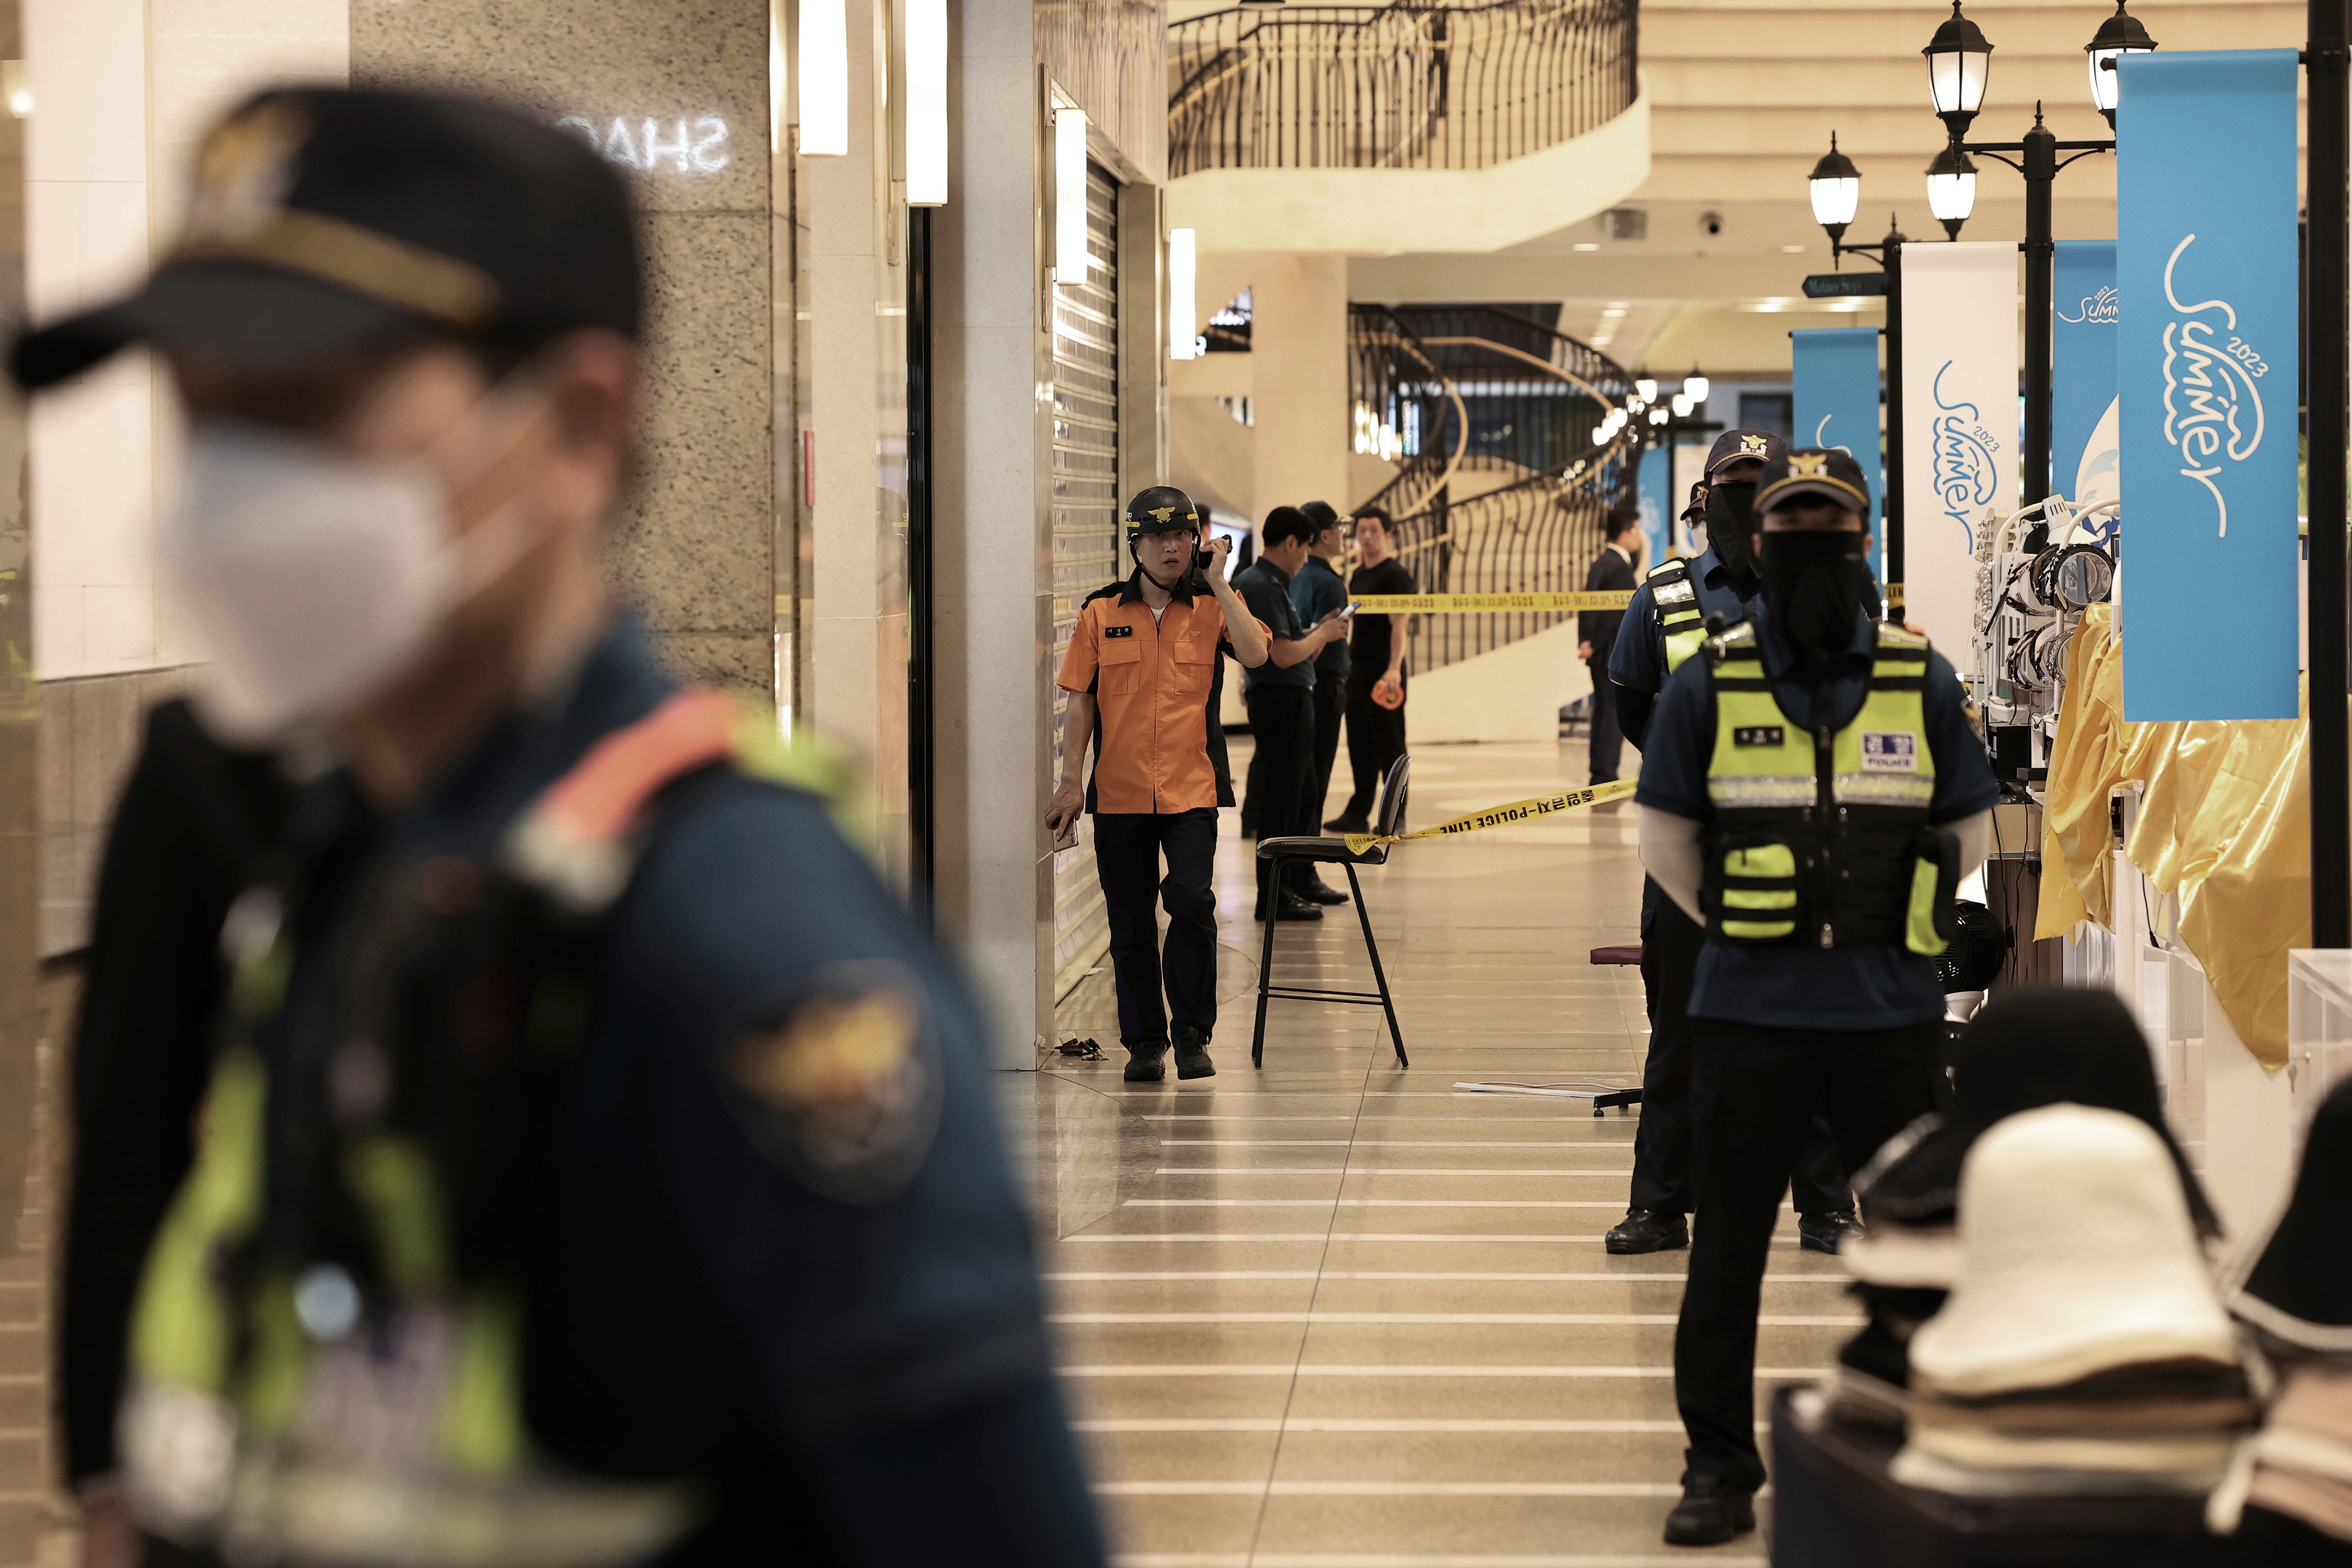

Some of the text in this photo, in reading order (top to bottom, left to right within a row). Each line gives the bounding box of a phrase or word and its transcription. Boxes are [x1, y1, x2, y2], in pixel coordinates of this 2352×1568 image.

[2093, 285, 2110, 302] 2023
[2225, 336, 2269, 378] 2023
[1974, 426, 2000, 452] 2023
